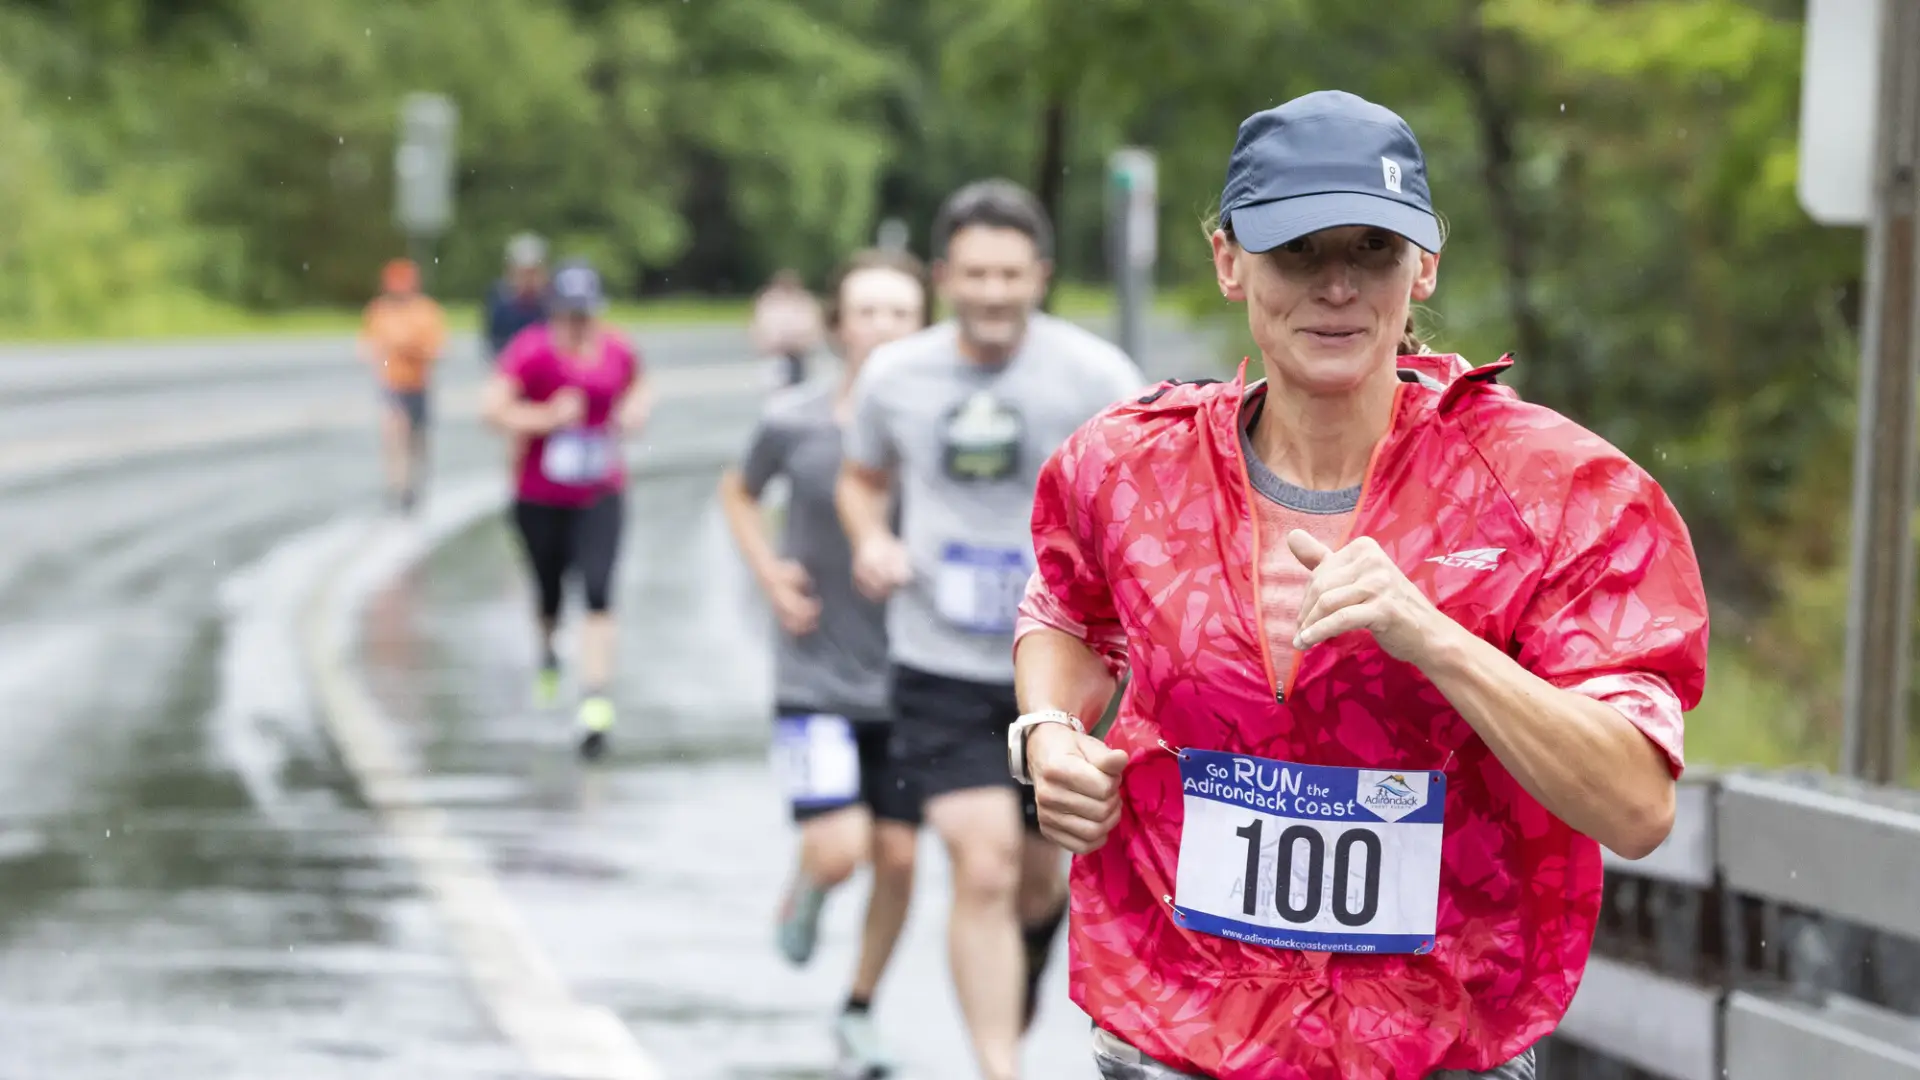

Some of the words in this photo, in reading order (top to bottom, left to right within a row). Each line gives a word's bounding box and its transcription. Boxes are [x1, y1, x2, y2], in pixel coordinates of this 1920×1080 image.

[1183, 777, 1287, 812] Adirondack
[1294, 797, 1356, 817] Coast
[1206, 763, 1229, 779] Go
[1232, 757, 1303, 796] RUN
[1306, 784, 1330, 798] the
[1364, 795, 1418, 806] Adirondack
[1236, 818, 1382, 927] 100
[1222, 928, 1376, 952] www.adirondackcoastevents.com
